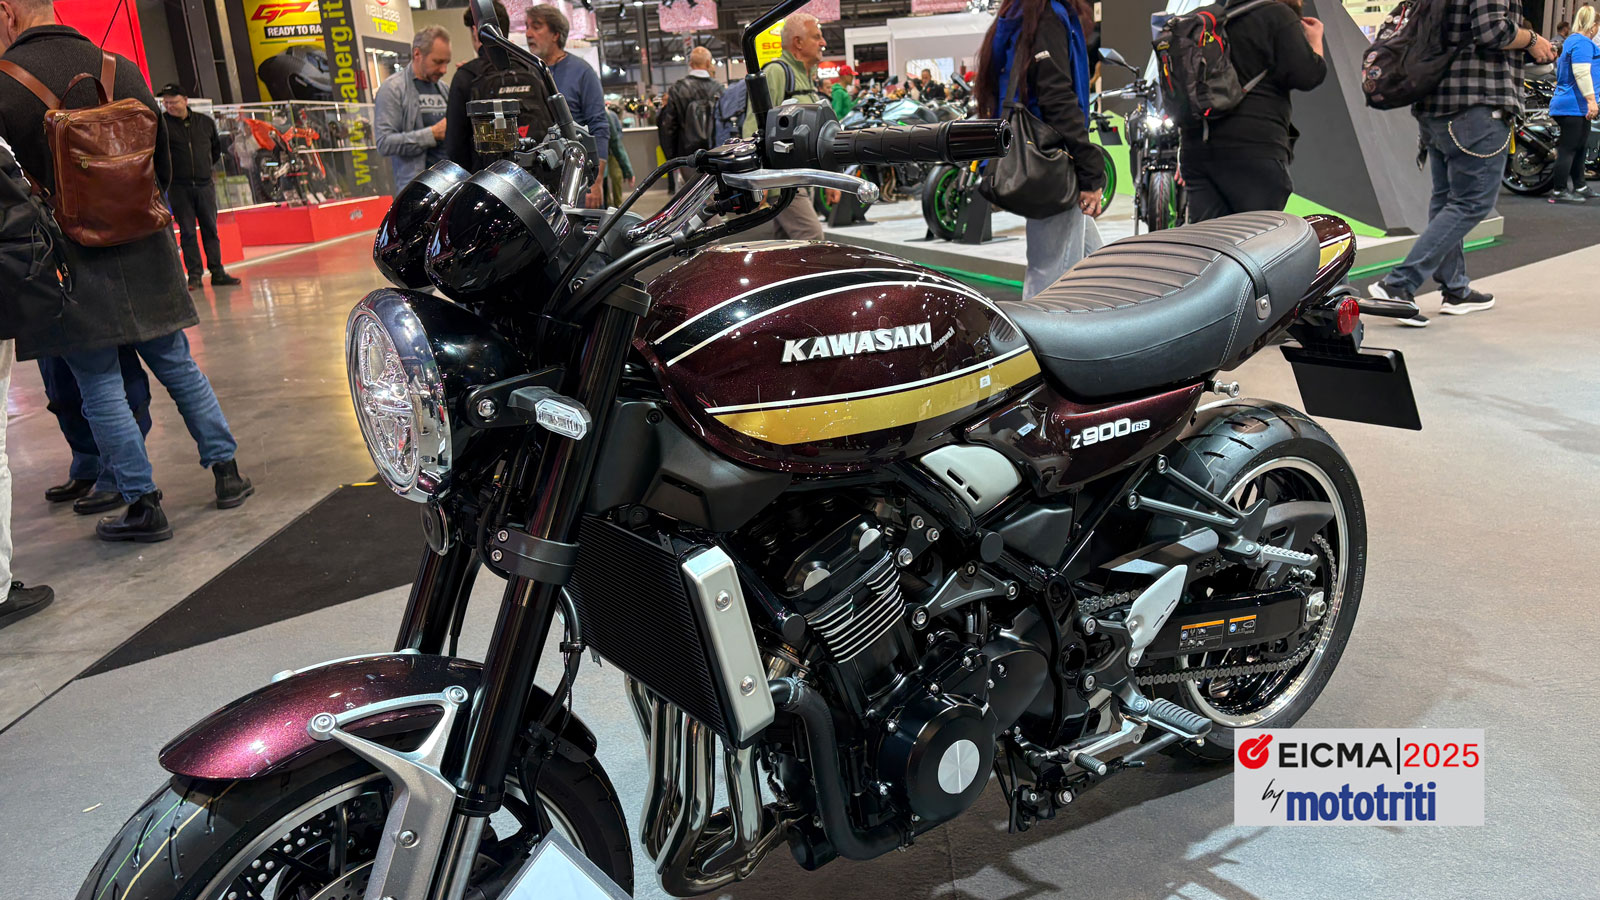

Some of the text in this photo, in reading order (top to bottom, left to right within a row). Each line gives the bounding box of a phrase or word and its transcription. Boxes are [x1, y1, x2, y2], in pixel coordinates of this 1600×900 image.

[267, 24, 323, 37] READY TO RA
[781, 322, 933, 363] KAWASAKI
